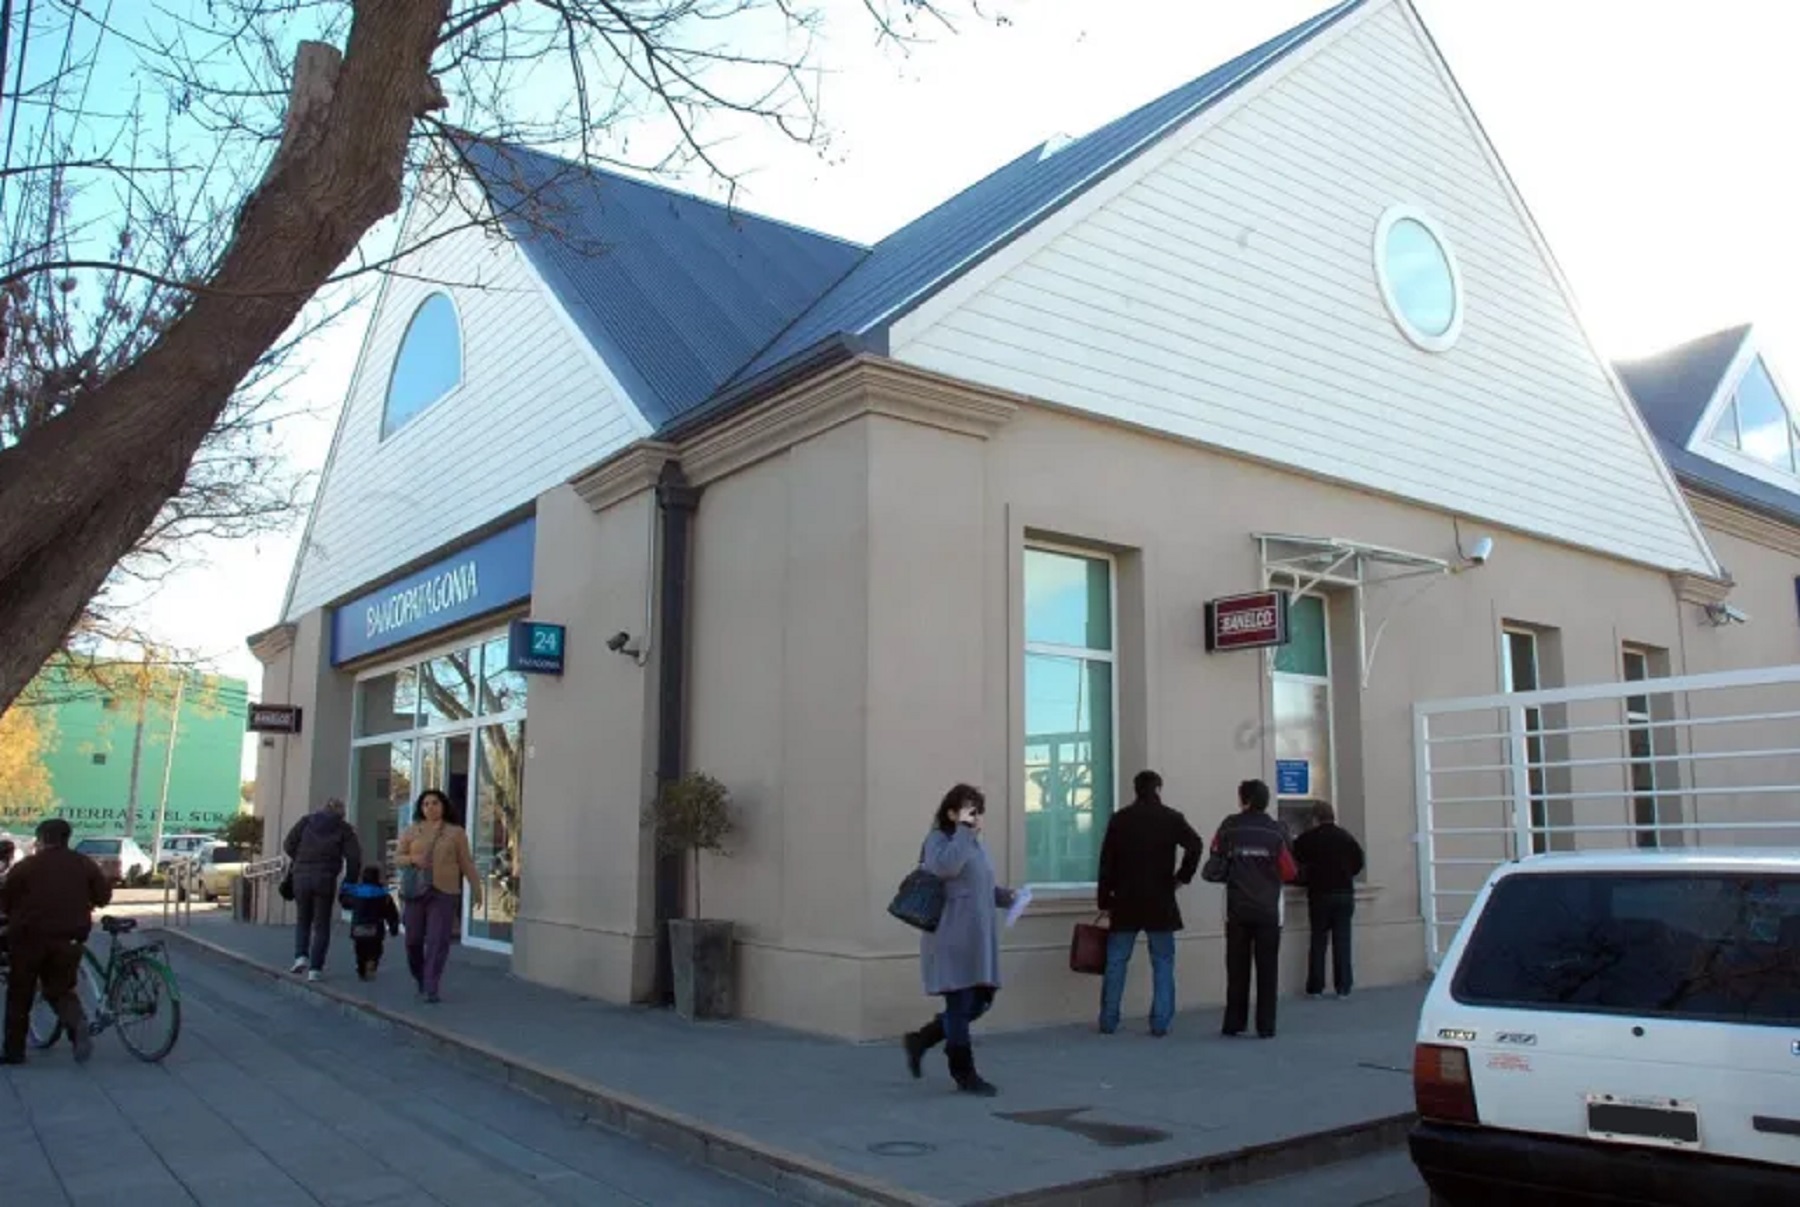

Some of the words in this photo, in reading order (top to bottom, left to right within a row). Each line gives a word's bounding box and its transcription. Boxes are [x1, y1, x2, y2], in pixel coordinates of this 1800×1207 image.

[366, 560, 478, 639] BANCOPATAGONIA
[1221, 610, 1272, 633] BANELCO
[535, 631, 556, 650] 24
[55, 806, 143, 820] TIERRAS
